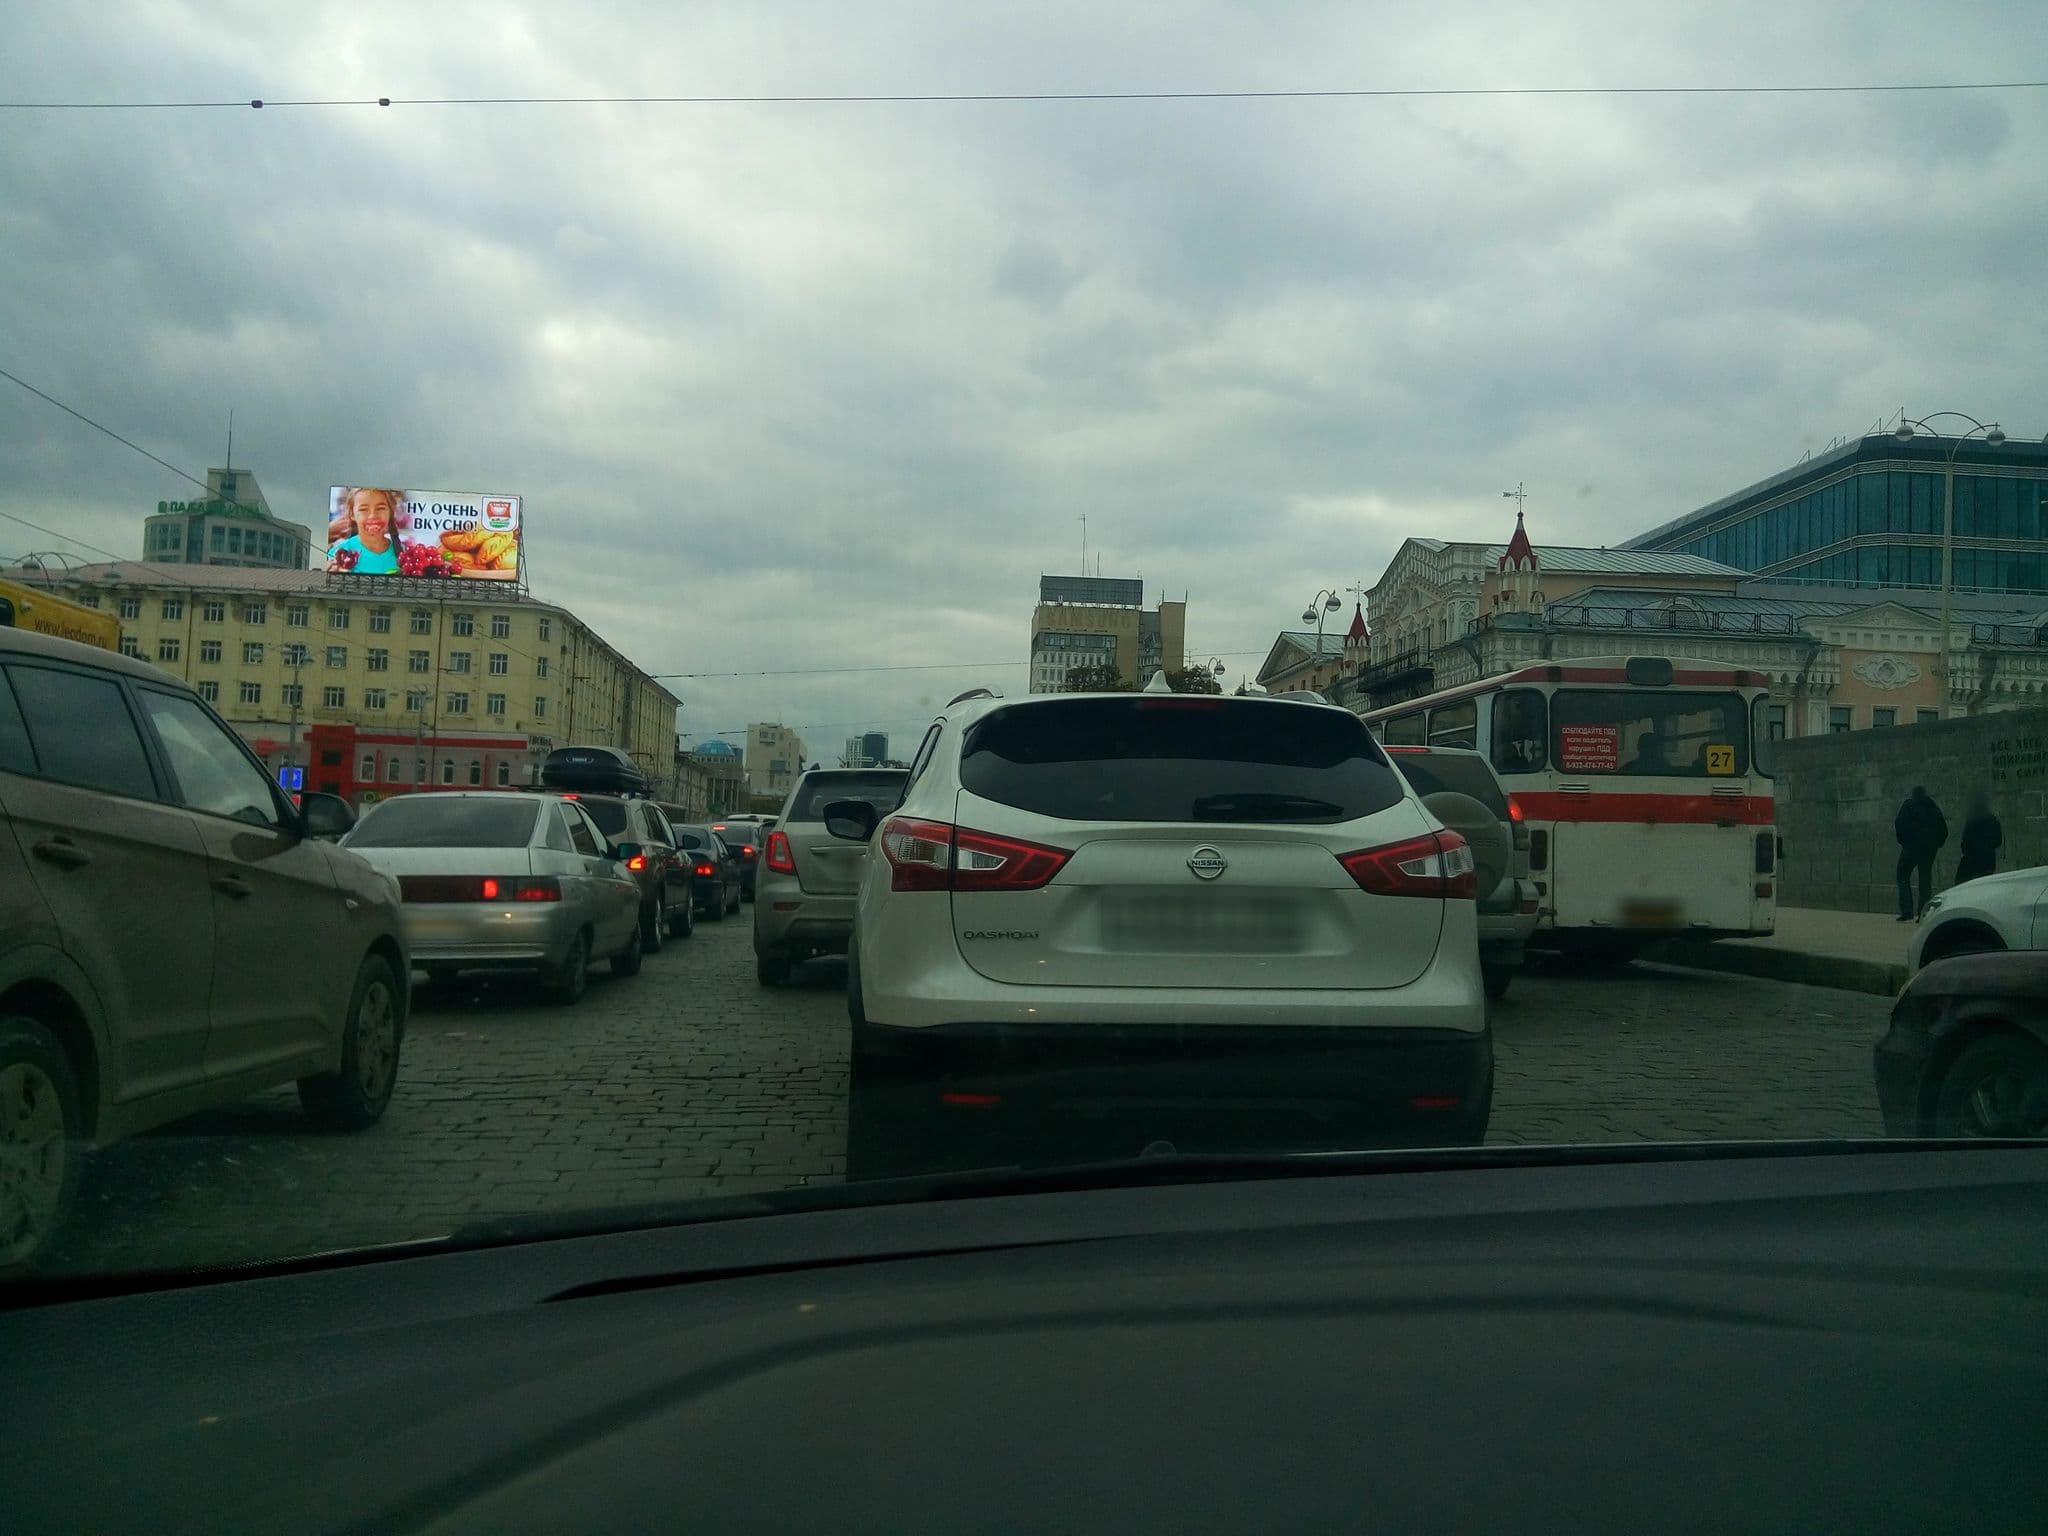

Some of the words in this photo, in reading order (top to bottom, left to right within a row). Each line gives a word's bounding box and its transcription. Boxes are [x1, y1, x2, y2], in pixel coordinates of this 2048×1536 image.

[407, 502, 426, 514] НУ
[431, 503, 479, 517] ОЧЕНЬ
[414, 518, 478, 532] ВКУСНО!
[1597, 745, 1611, 753] ПДД
[1710, 752, 1731, 767] 27
